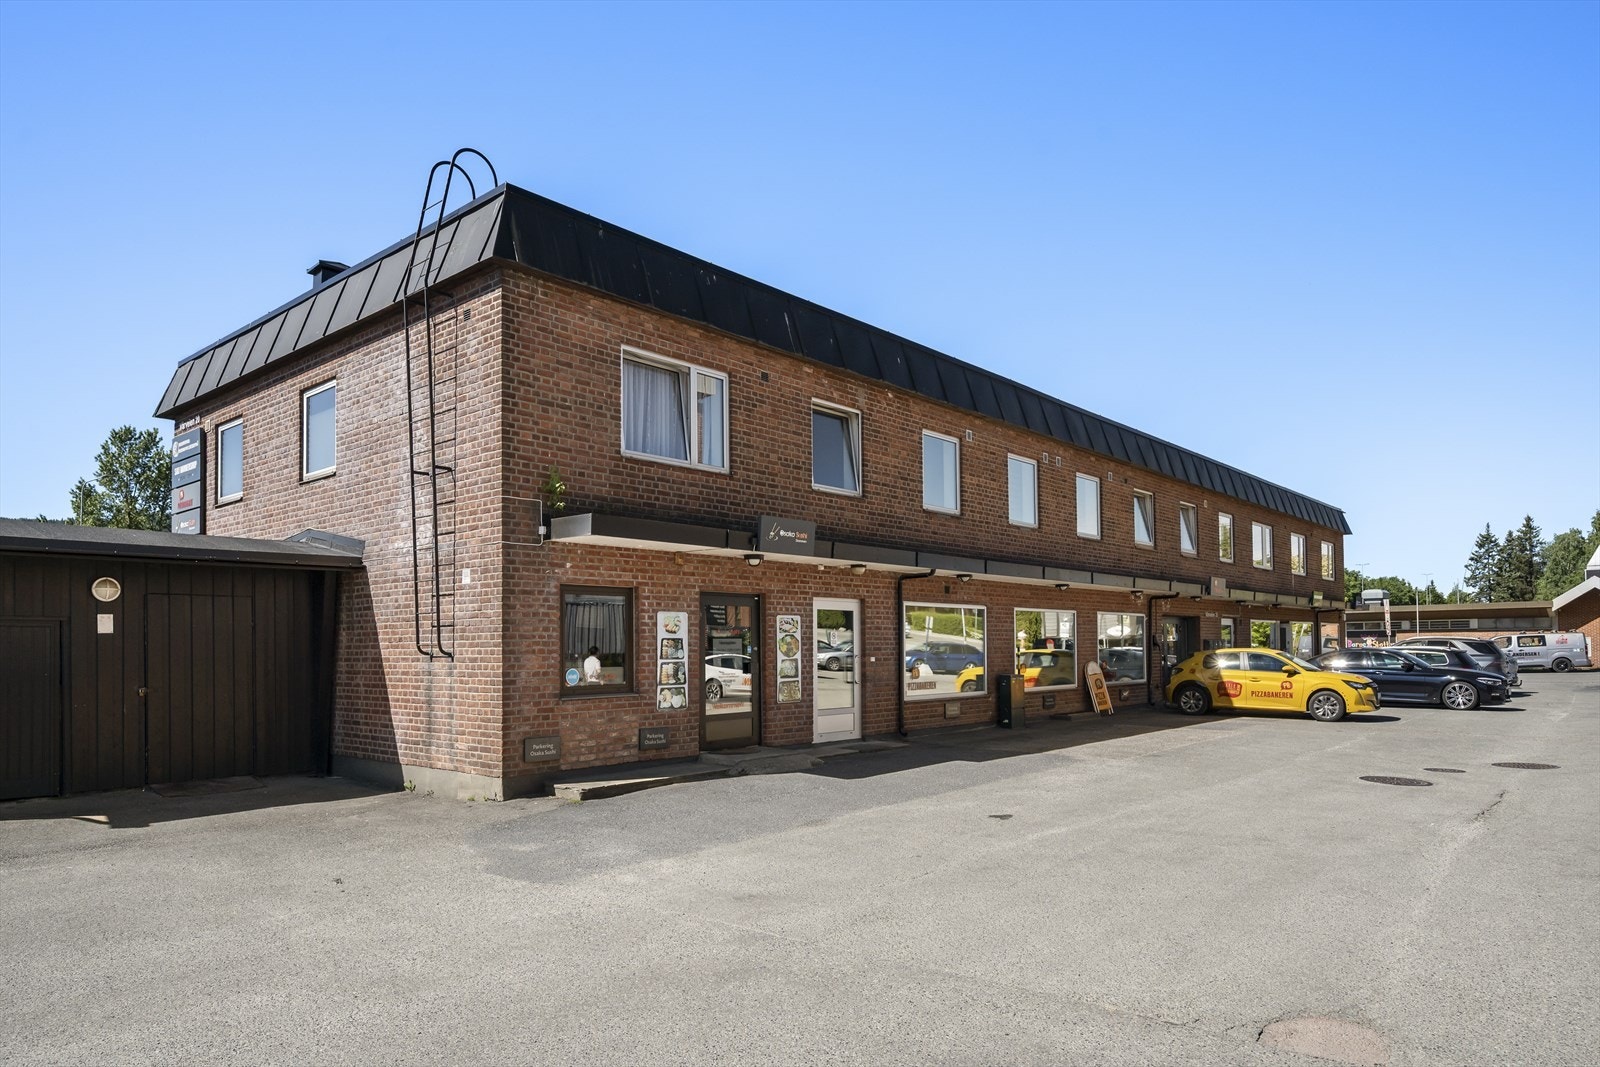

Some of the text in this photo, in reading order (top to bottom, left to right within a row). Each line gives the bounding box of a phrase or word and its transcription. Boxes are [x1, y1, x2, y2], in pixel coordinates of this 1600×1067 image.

[1250, 690, 1294, 699] PIZZABAKEREN
[532, 743, 554, 751] Parkering
[530, 750, 545, 758] Osaka
